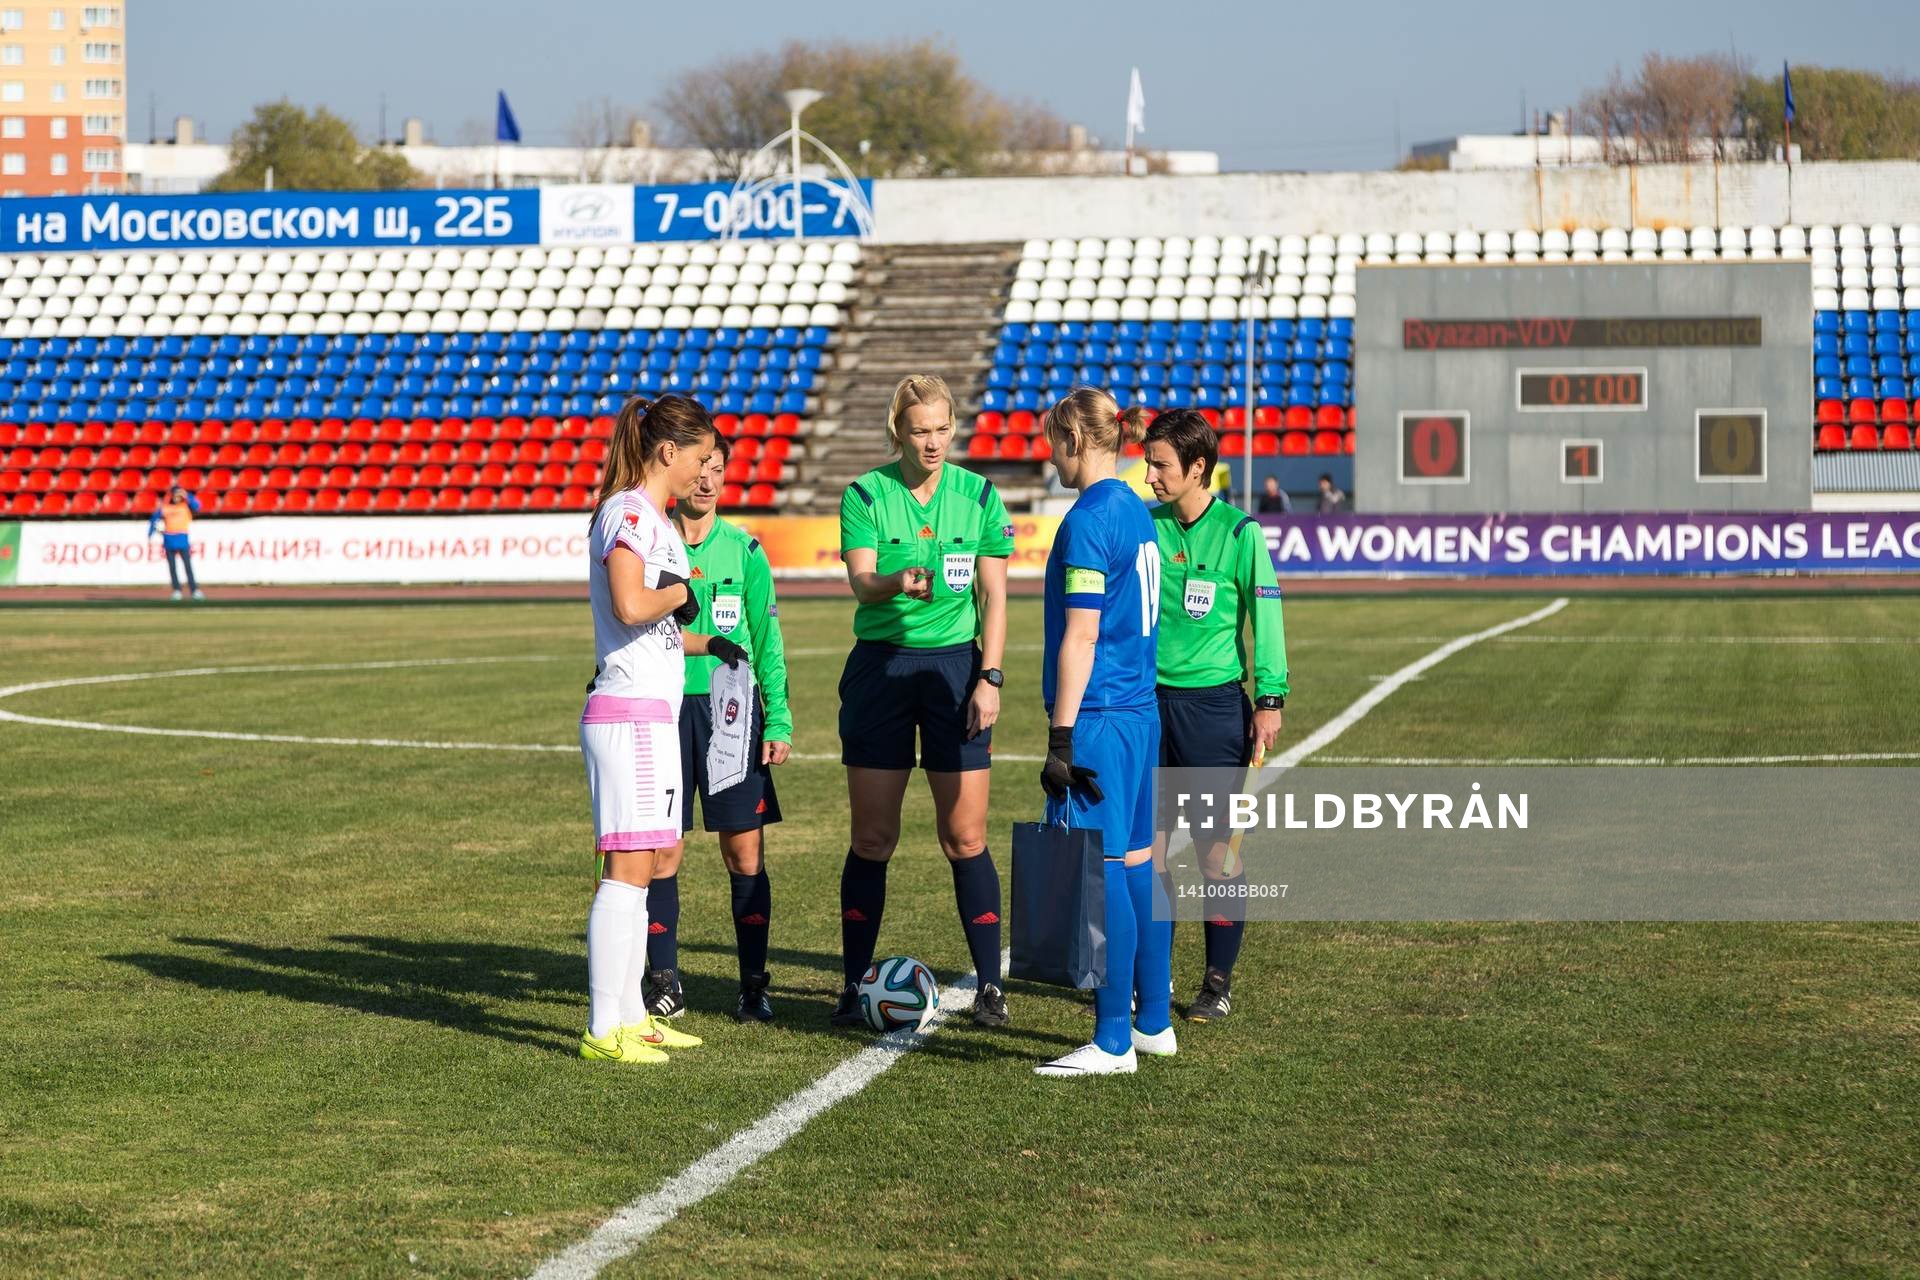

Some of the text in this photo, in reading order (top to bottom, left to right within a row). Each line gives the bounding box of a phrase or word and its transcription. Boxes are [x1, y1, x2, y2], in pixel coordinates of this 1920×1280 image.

[17, 211, 67, 244] на
[82, 201, 359, 243] Московском
[434, 196, 513, 239] 22Б
[1404, 318, 1575, 350] Ryazan-VDV
[1548, 374, 1637, 405] 0:00
[1413, 418, 1458, 477] 0
[1709, 415, 1755, 473] 0
[1573, 446, 1589, 477] 1
[342, 538, 490, 560] СИЛЬНАЯ
[1316, 525, 1530, 563] WOMEN'S
[1540, 523, 1808, 562] CHAMPIONS
[947, 569, 970, 577] FIFA
[1136, 541, 1160, 637] 19
[1187, 594, 1209, 605] FIFA
[715, 610, 737, 619] FIFA
[665, 788, 675, 818] 7
